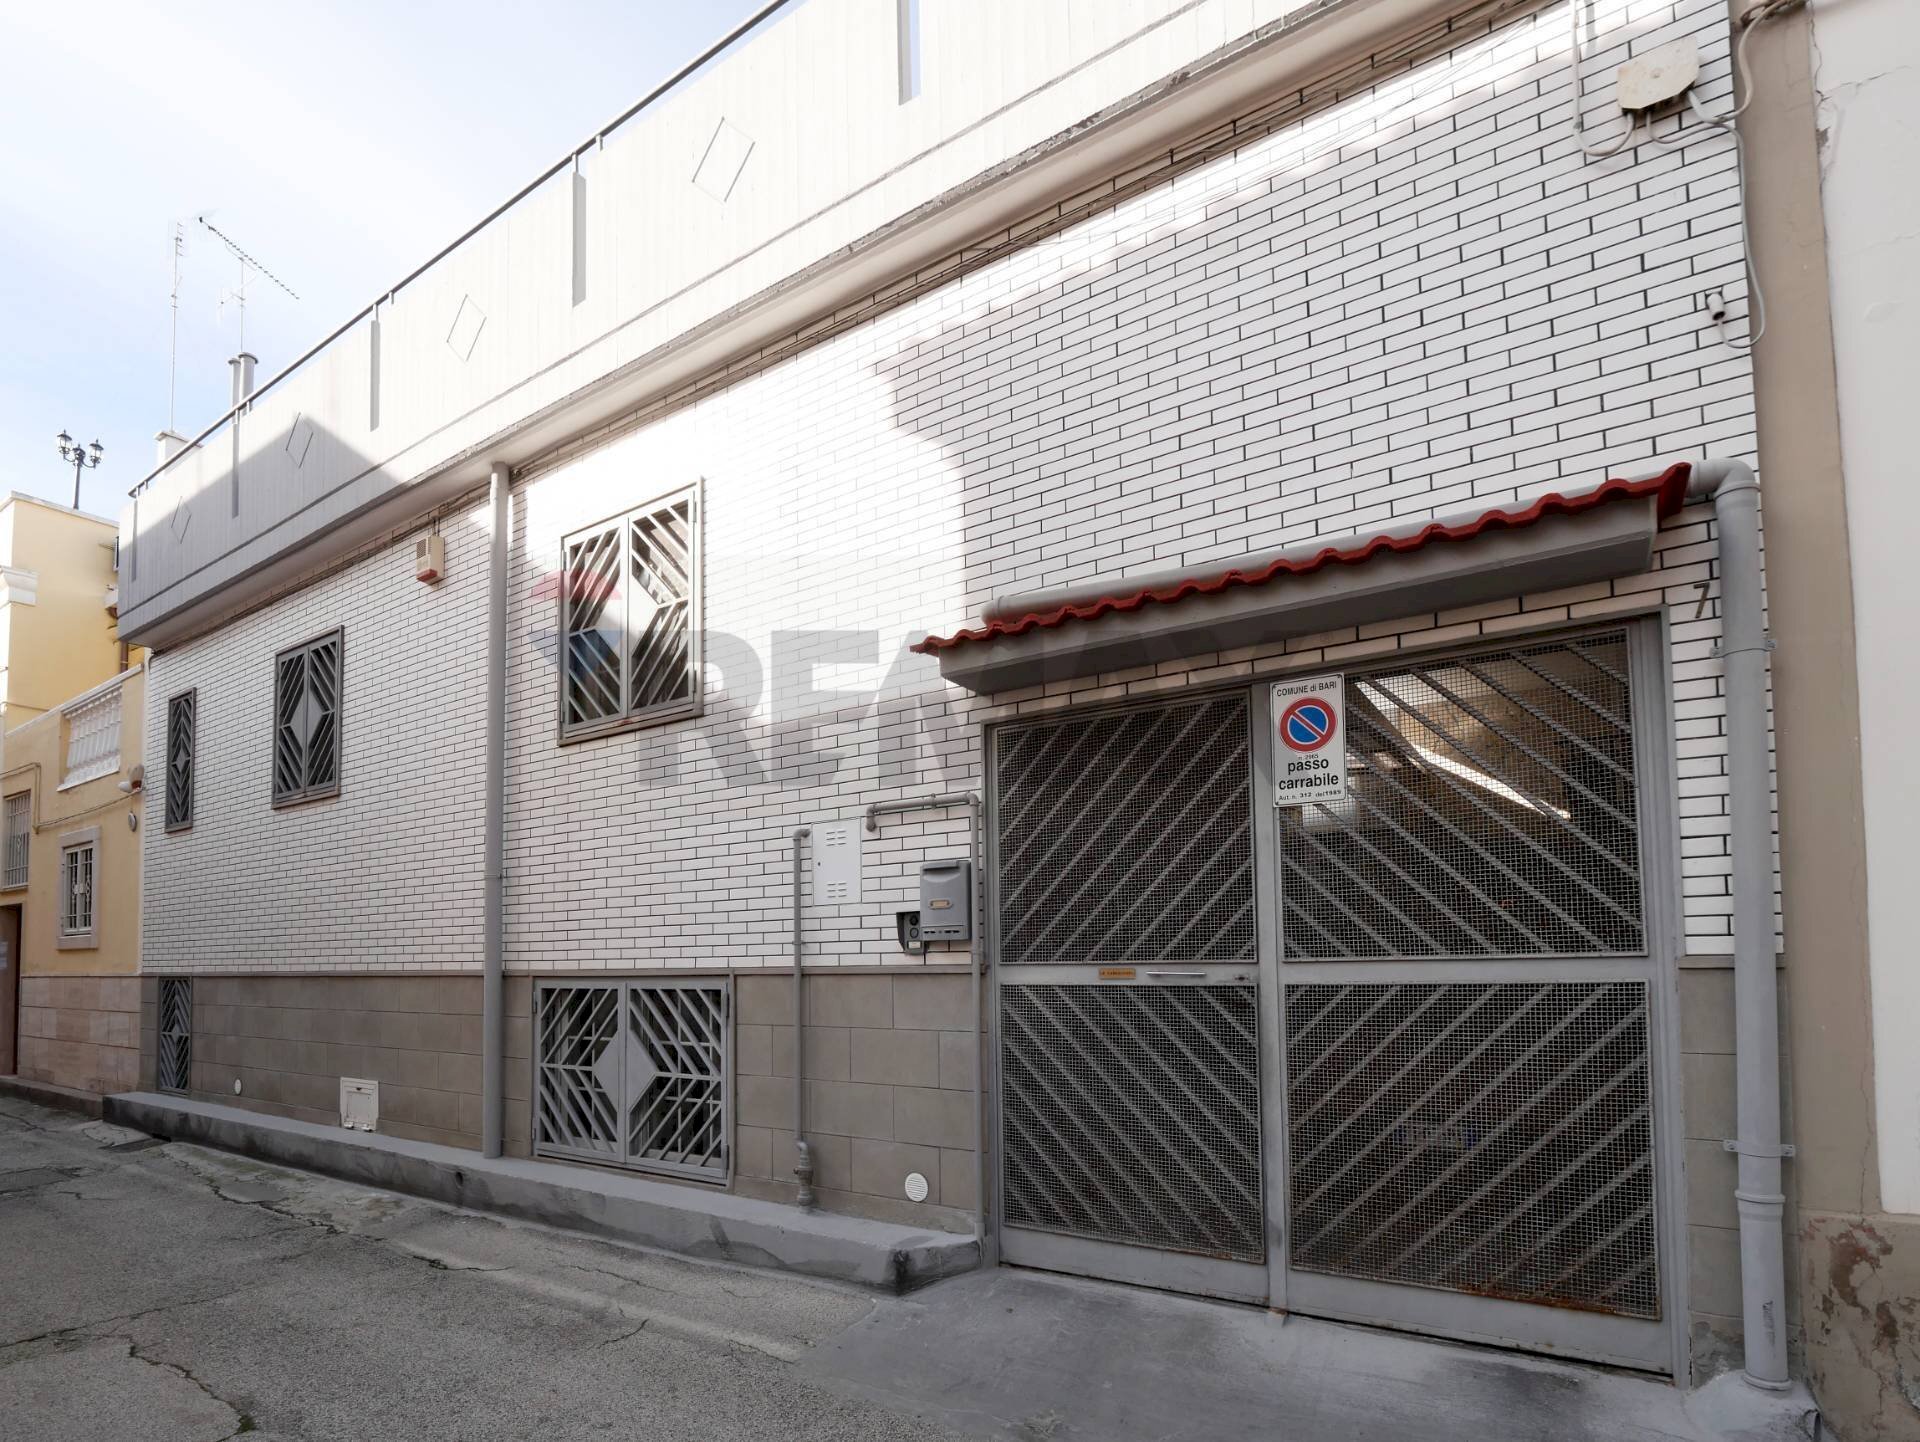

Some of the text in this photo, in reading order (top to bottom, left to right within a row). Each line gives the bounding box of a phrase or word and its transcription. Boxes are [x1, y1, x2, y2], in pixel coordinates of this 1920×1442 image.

[1693, 582, 1710, 618] 7
[1277, 681, 1337, 696] COMUNE di BARI
[1288, 759, 1329, 775] passo
[1279, 773, 1339, 790] carrabile
